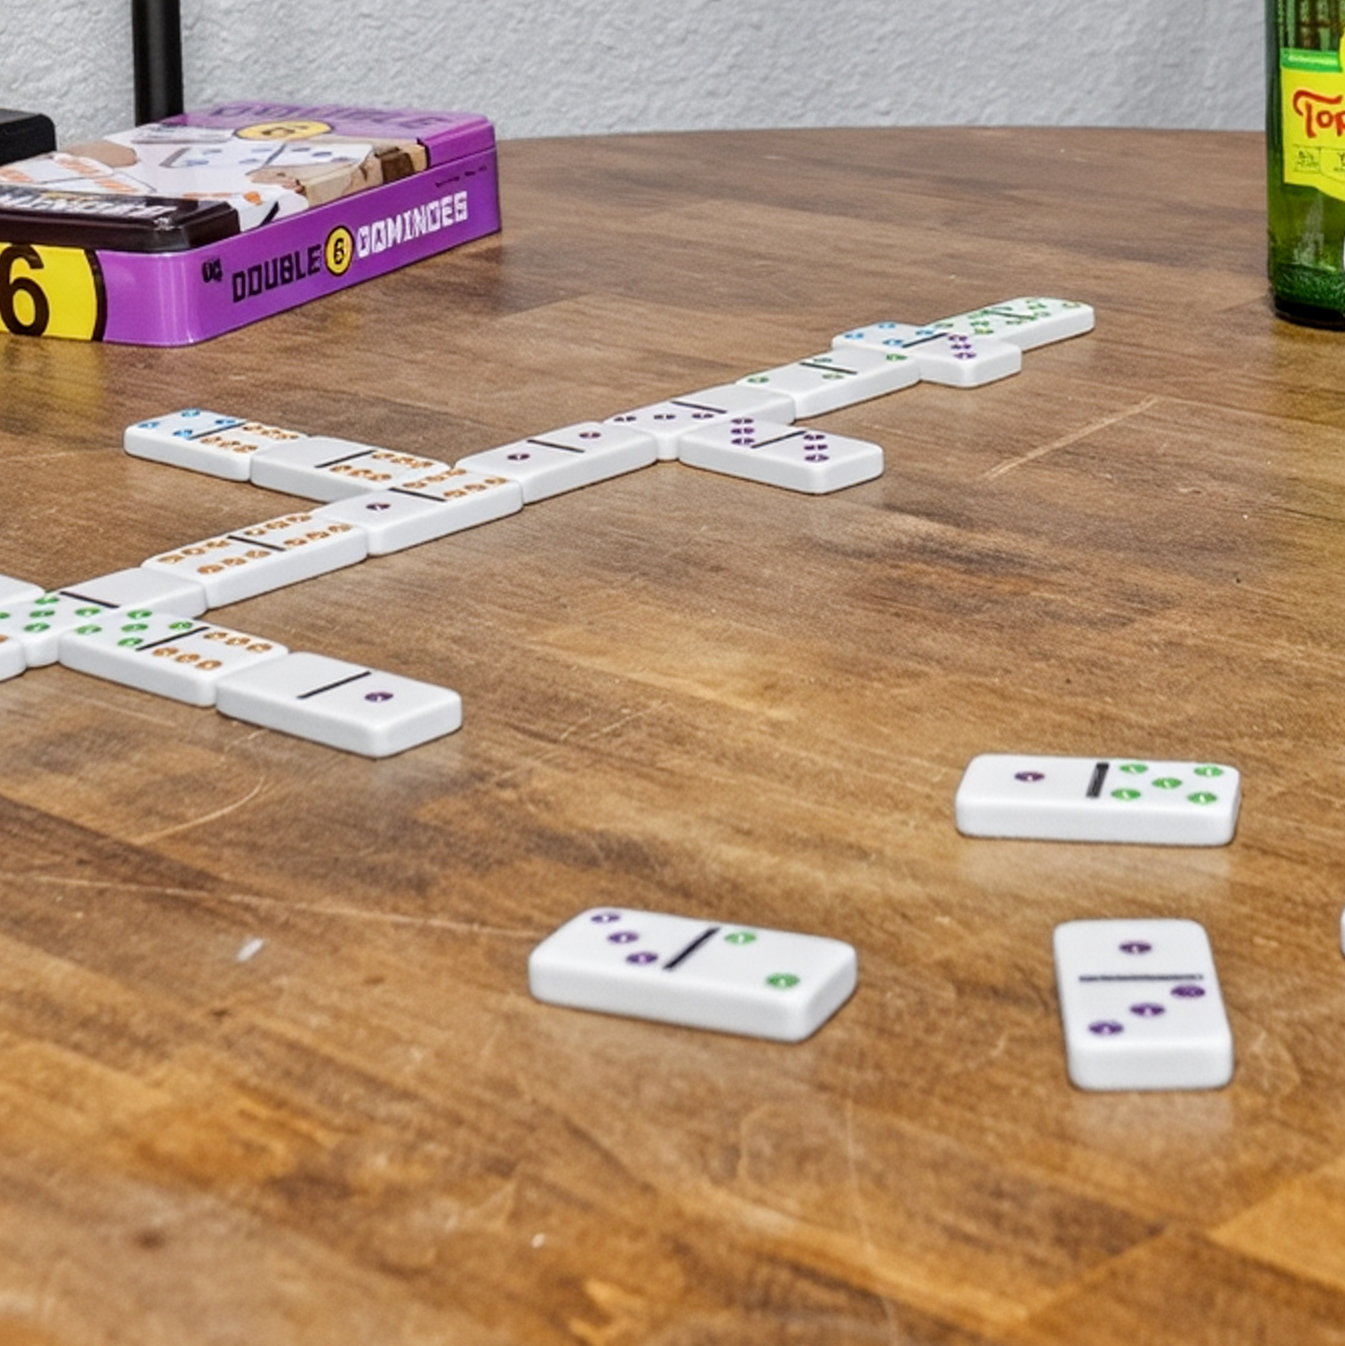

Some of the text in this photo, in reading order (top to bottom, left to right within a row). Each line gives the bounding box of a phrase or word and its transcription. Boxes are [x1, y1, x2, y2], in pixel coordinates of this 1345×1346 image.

[232, 190, 468, 303] DOUBLE 6 DOMINOES
